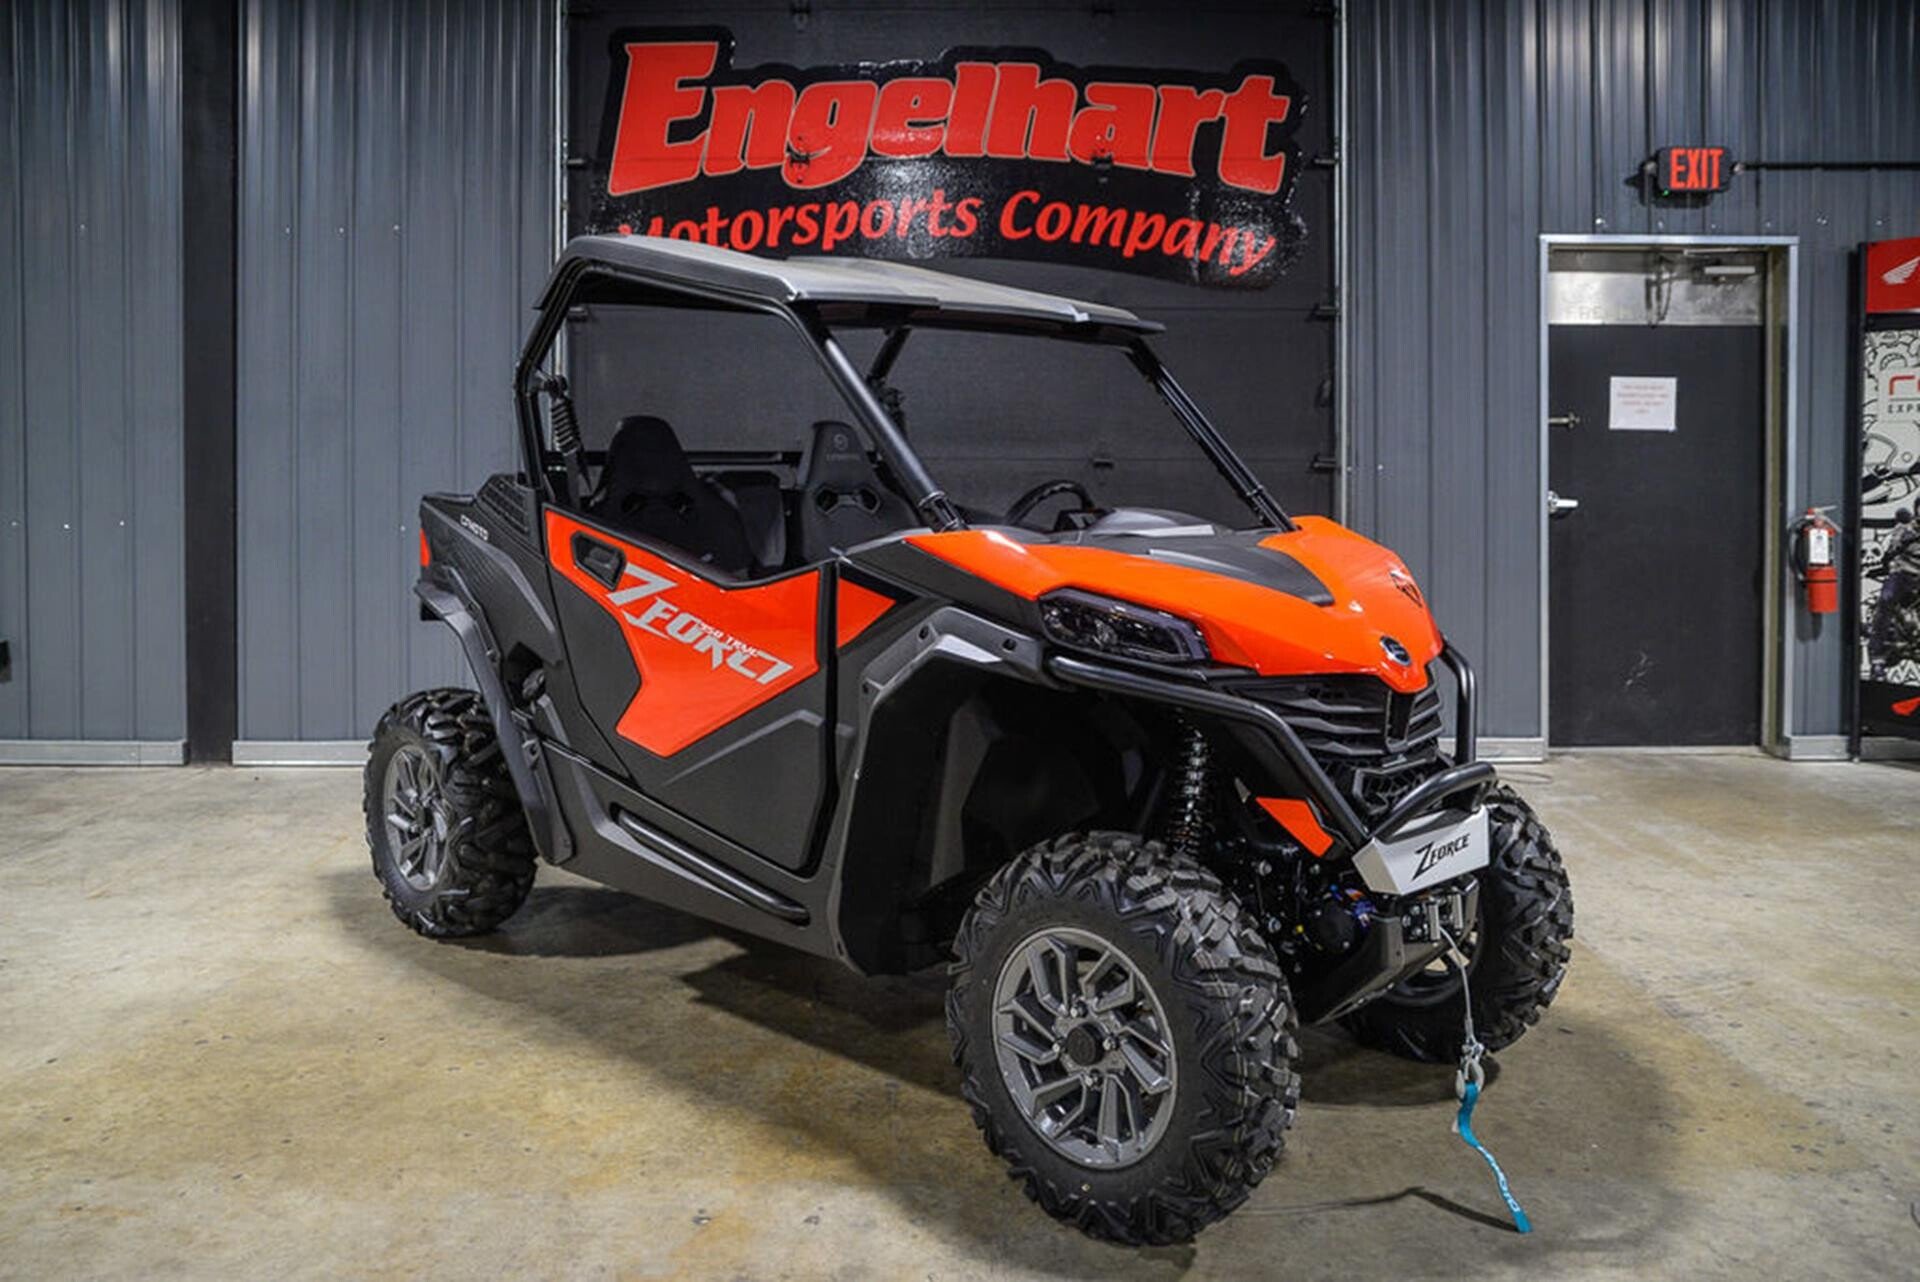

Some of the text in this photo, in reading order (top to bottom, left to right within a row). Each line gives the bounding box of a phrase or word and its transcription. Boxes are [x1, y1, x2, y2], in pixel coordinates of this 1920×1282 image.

[607, 41, 1291, 195] Engelhart
[1669, 147, 1724, 190] EXIT
[1000, 190, 1276, 276] Company
[1412, 833, 1470, 881] ZFORCE
